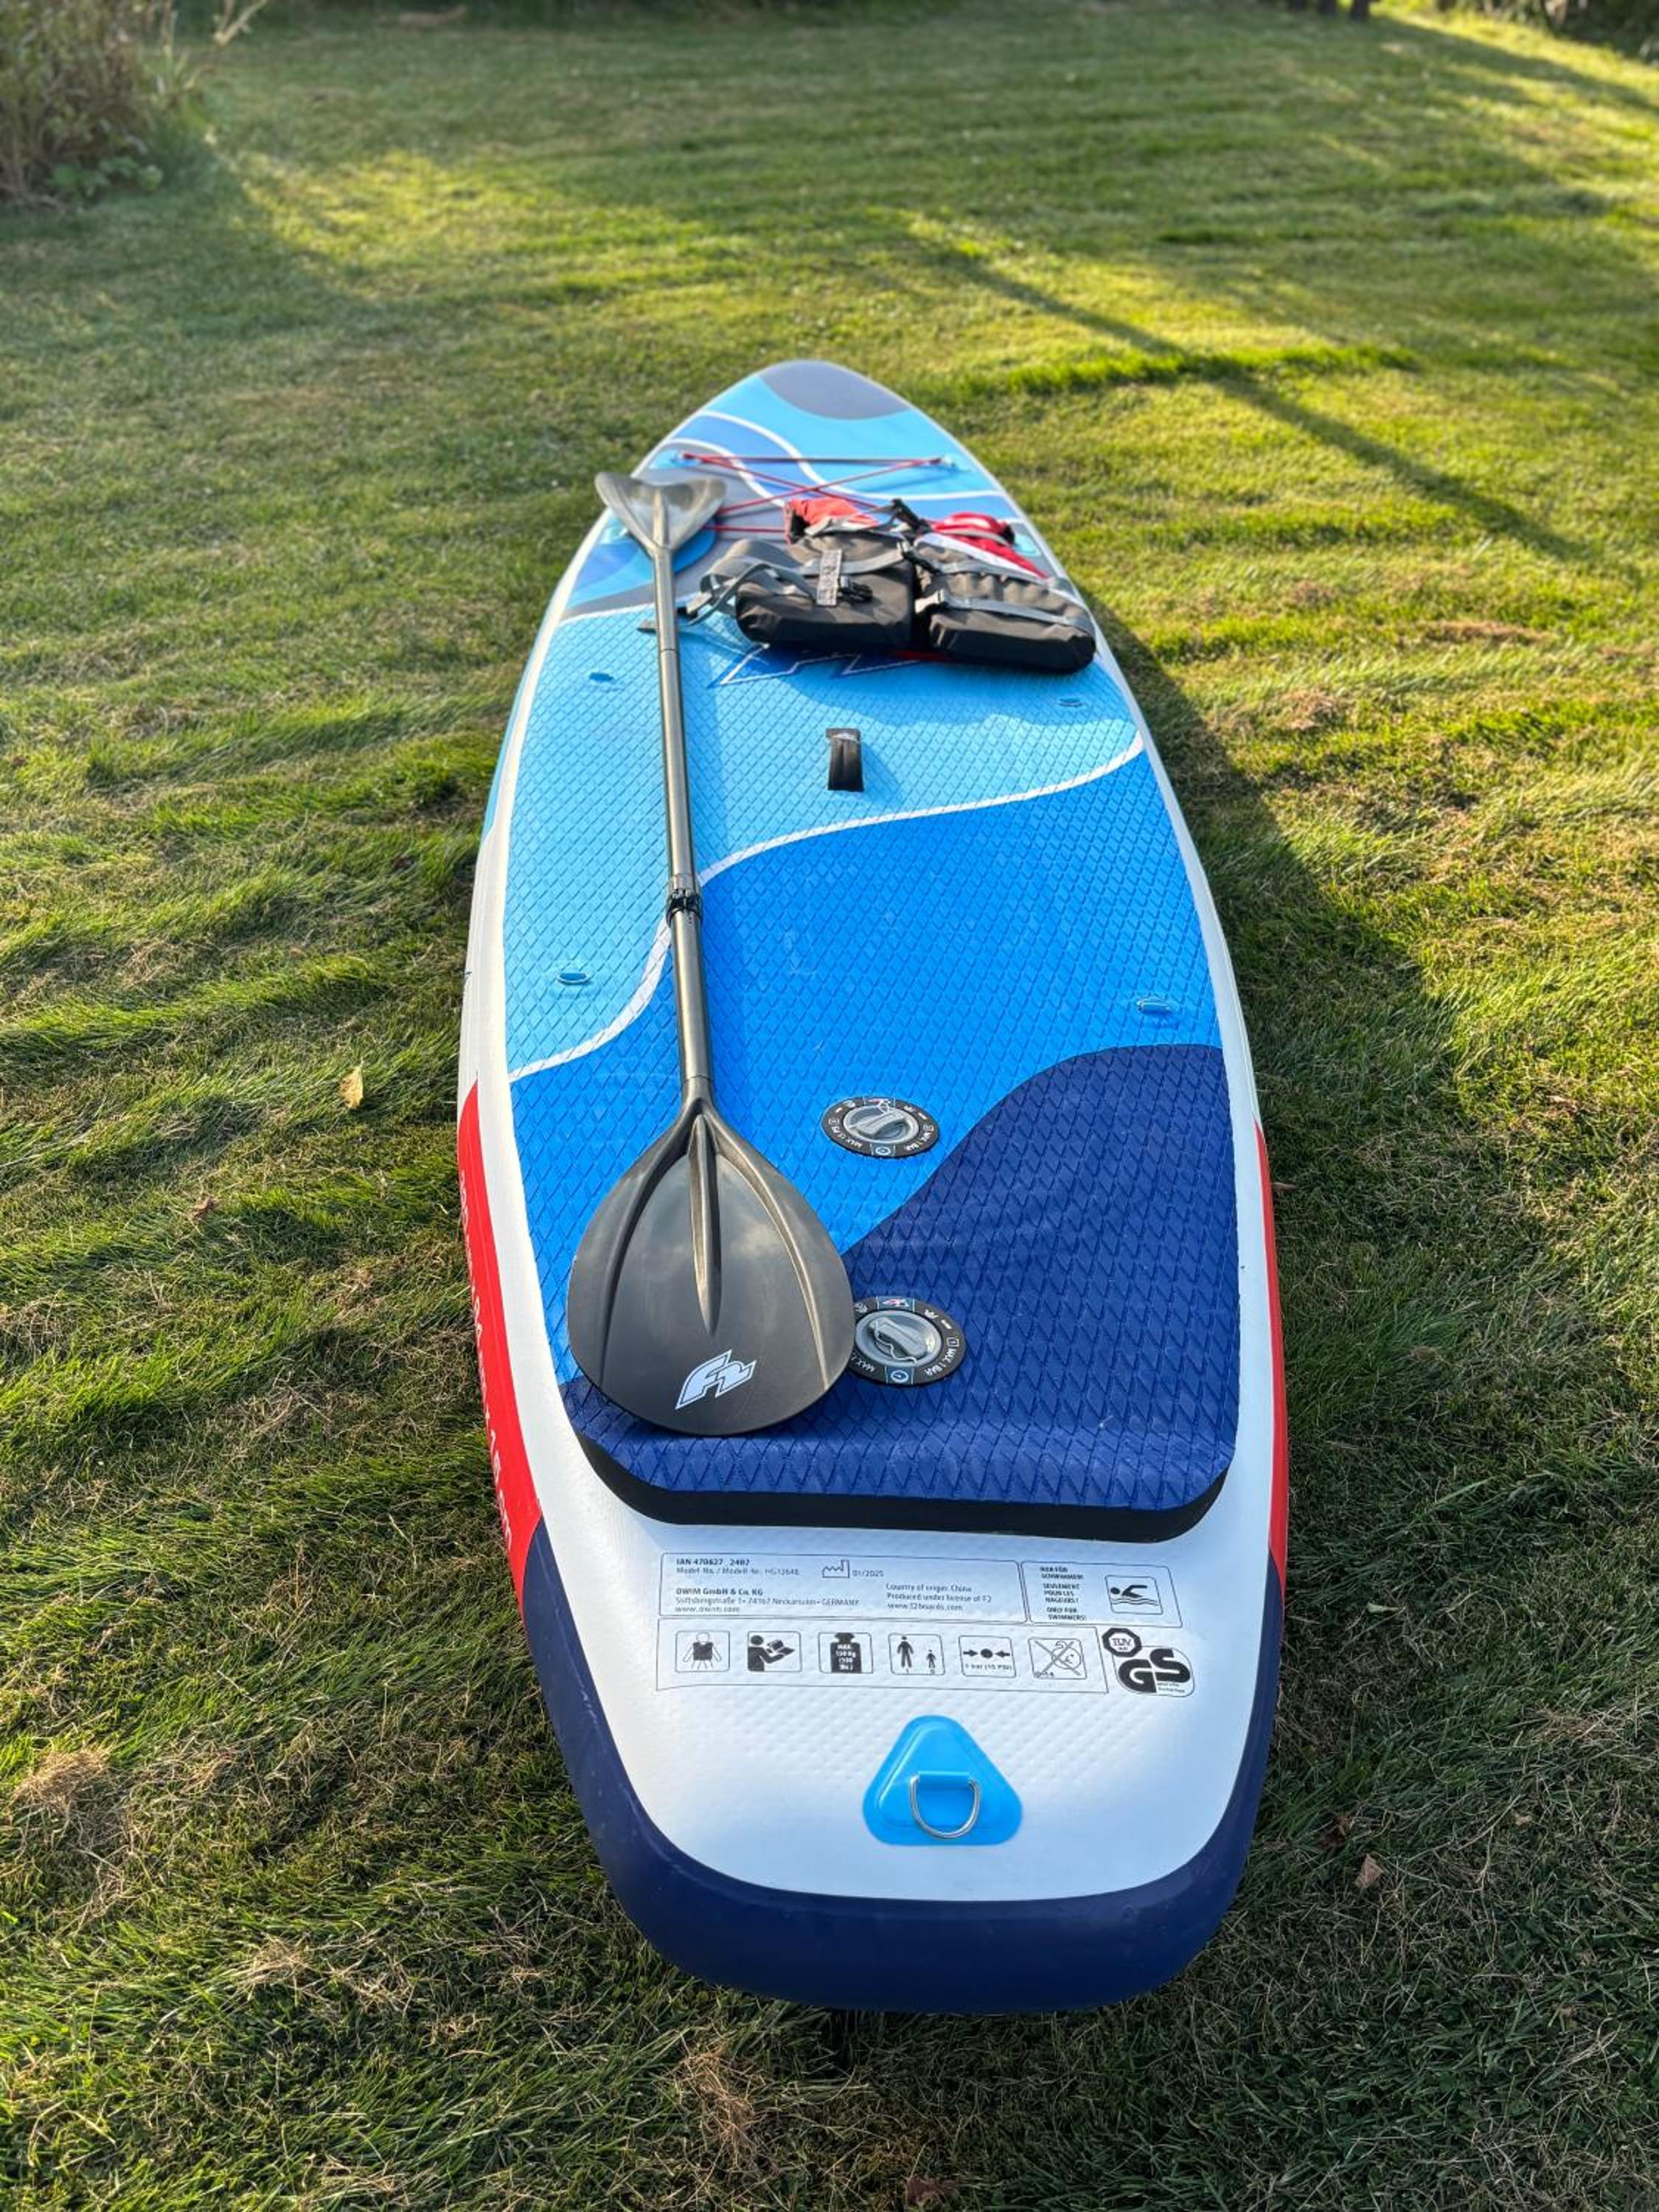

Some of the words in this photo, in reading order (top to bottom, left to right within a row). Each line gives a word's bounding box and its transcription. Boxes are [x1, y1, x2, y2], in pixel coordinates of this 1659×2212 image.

[676, 1558, 692, 1566] IAN
[852, 1569, 884, 1577] 01/2025
[886, 1583, 914, 1592] Country
[751, 1588, 763, 1596] KG
[1118, 1648, 1191, 1694] GS
